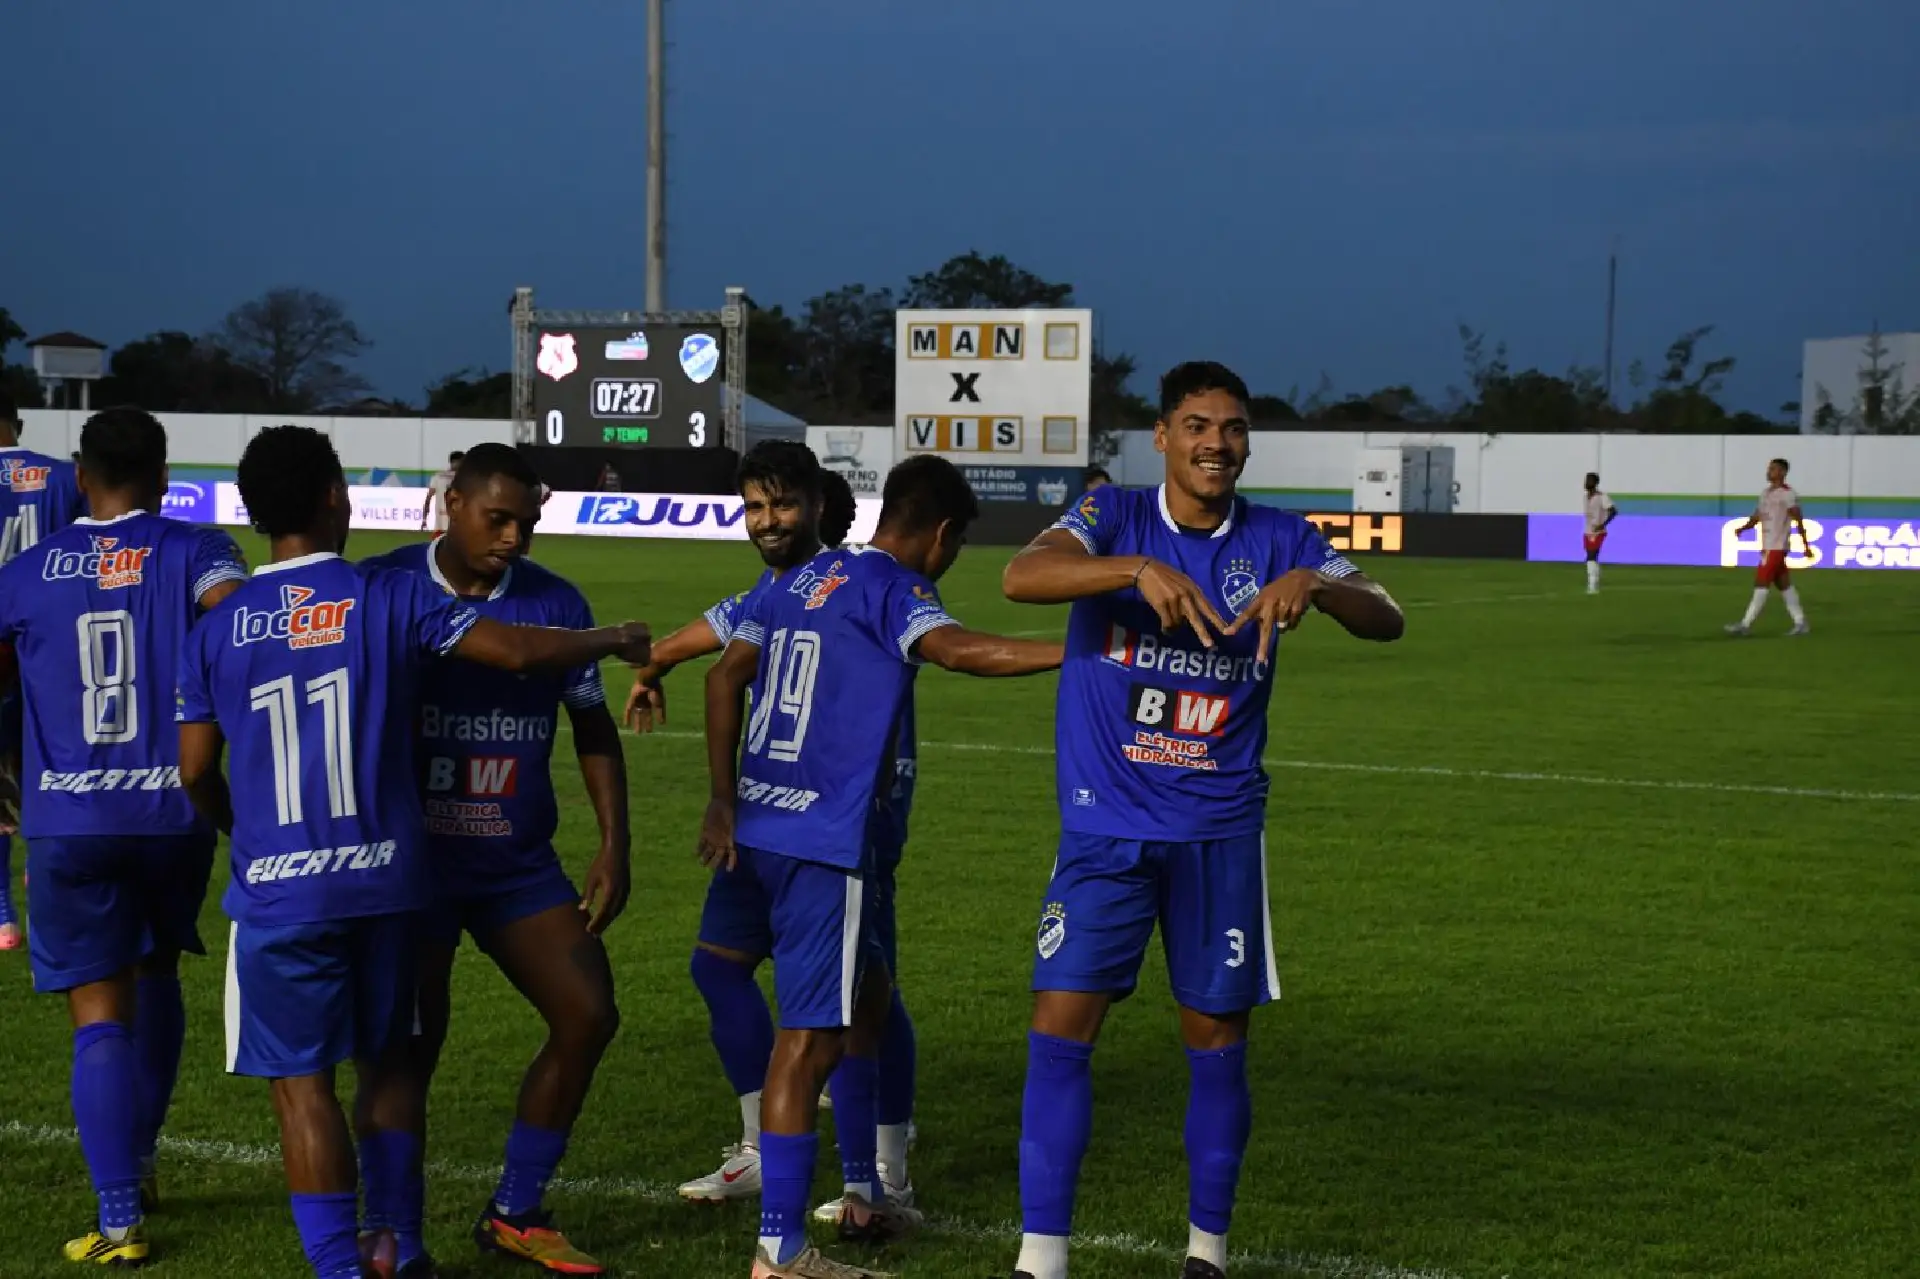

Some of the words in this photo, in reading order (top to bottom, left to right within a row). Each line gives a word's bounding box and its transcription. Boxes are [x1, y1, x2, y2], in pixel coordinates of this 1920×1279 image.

[913, 327, 1020, 354] MAN
[596, 382, 655, 413] 07:27
[949, 372, 981, 403] X
[547, 409, 563, 445] 0
[688, 411, 706, 447] 3
[913, 418, 1015, 446] VIS
[1834, 523, 1920, 546] GRÁ
[233, 599, 355, 646] loccar
[77, 609, 138, 745] 8
[748, 627, 821, 762] 19
[422, 704, 551, 741] Brasferro
[250, 667, 357, 827] 11
[1223, 928, 1245, 968] 3
